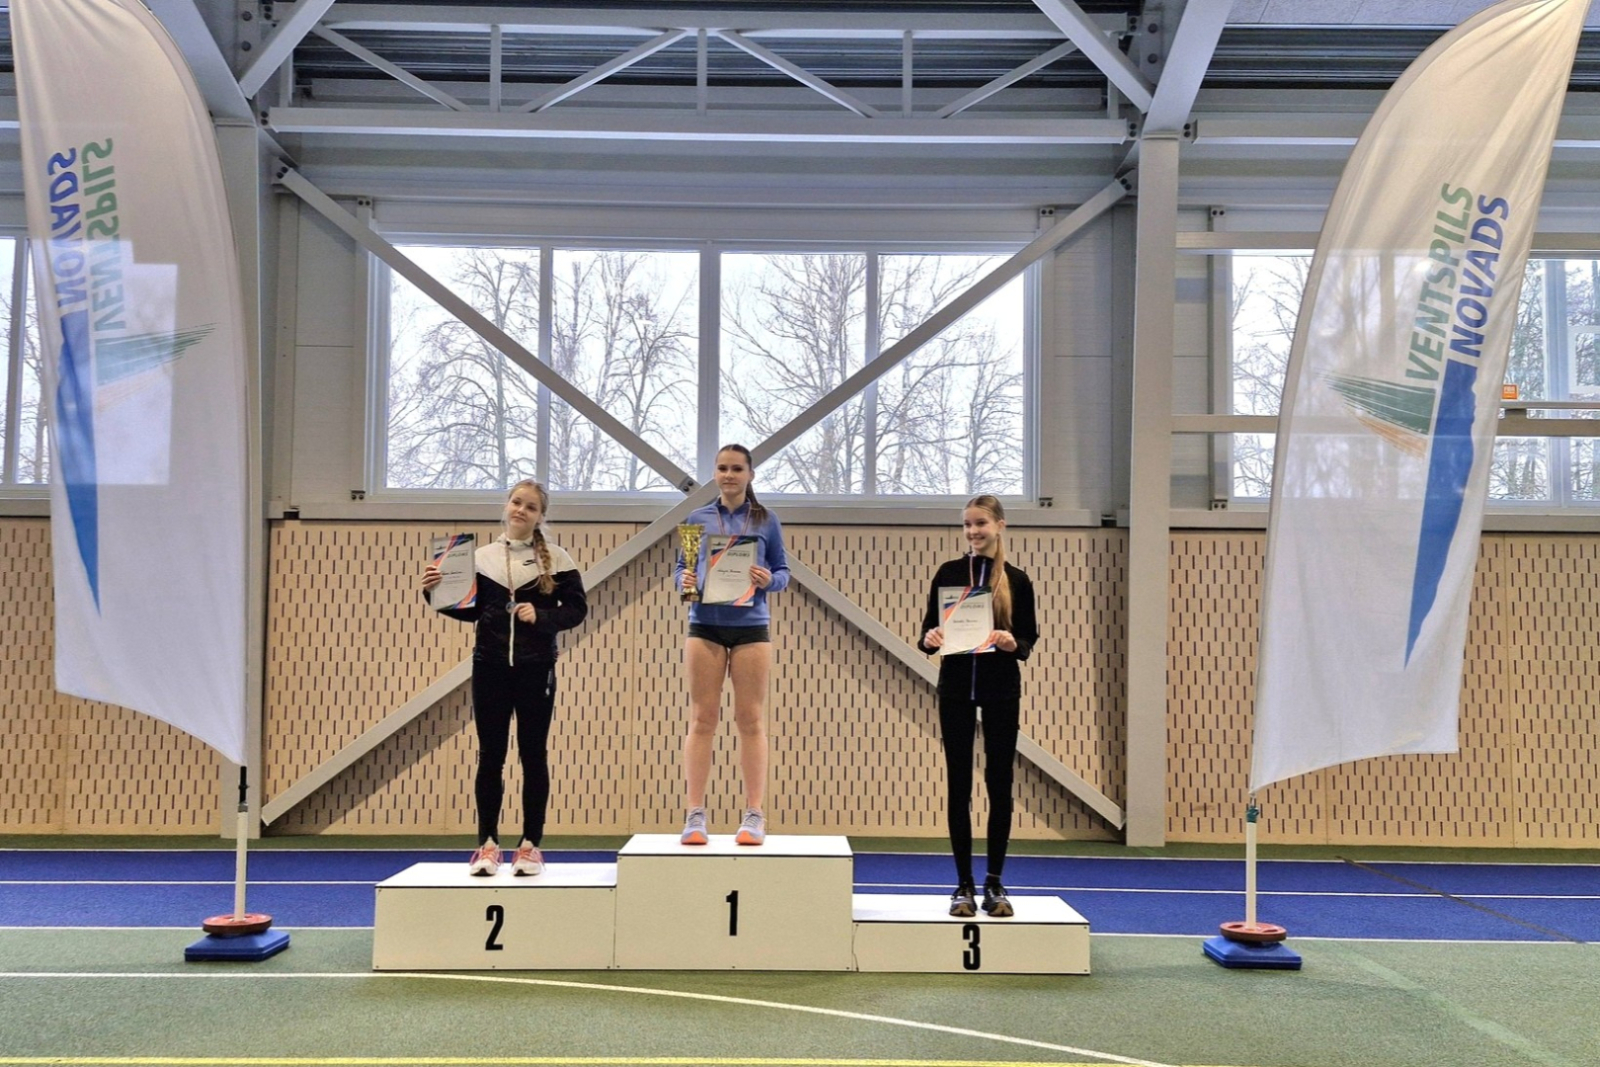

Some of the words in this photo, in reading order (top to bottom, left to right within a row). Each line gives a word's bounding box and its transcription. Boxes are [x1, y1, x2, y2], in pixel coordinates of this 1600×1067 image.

[1405, 183, 1474, 381] VENTSPILS
[1449, 194, 1509, 358] NOVADS
[484, 904, 504, 951] 2
[726, 890, 738, 937] 1
[962, 924, 981, 970] 3
